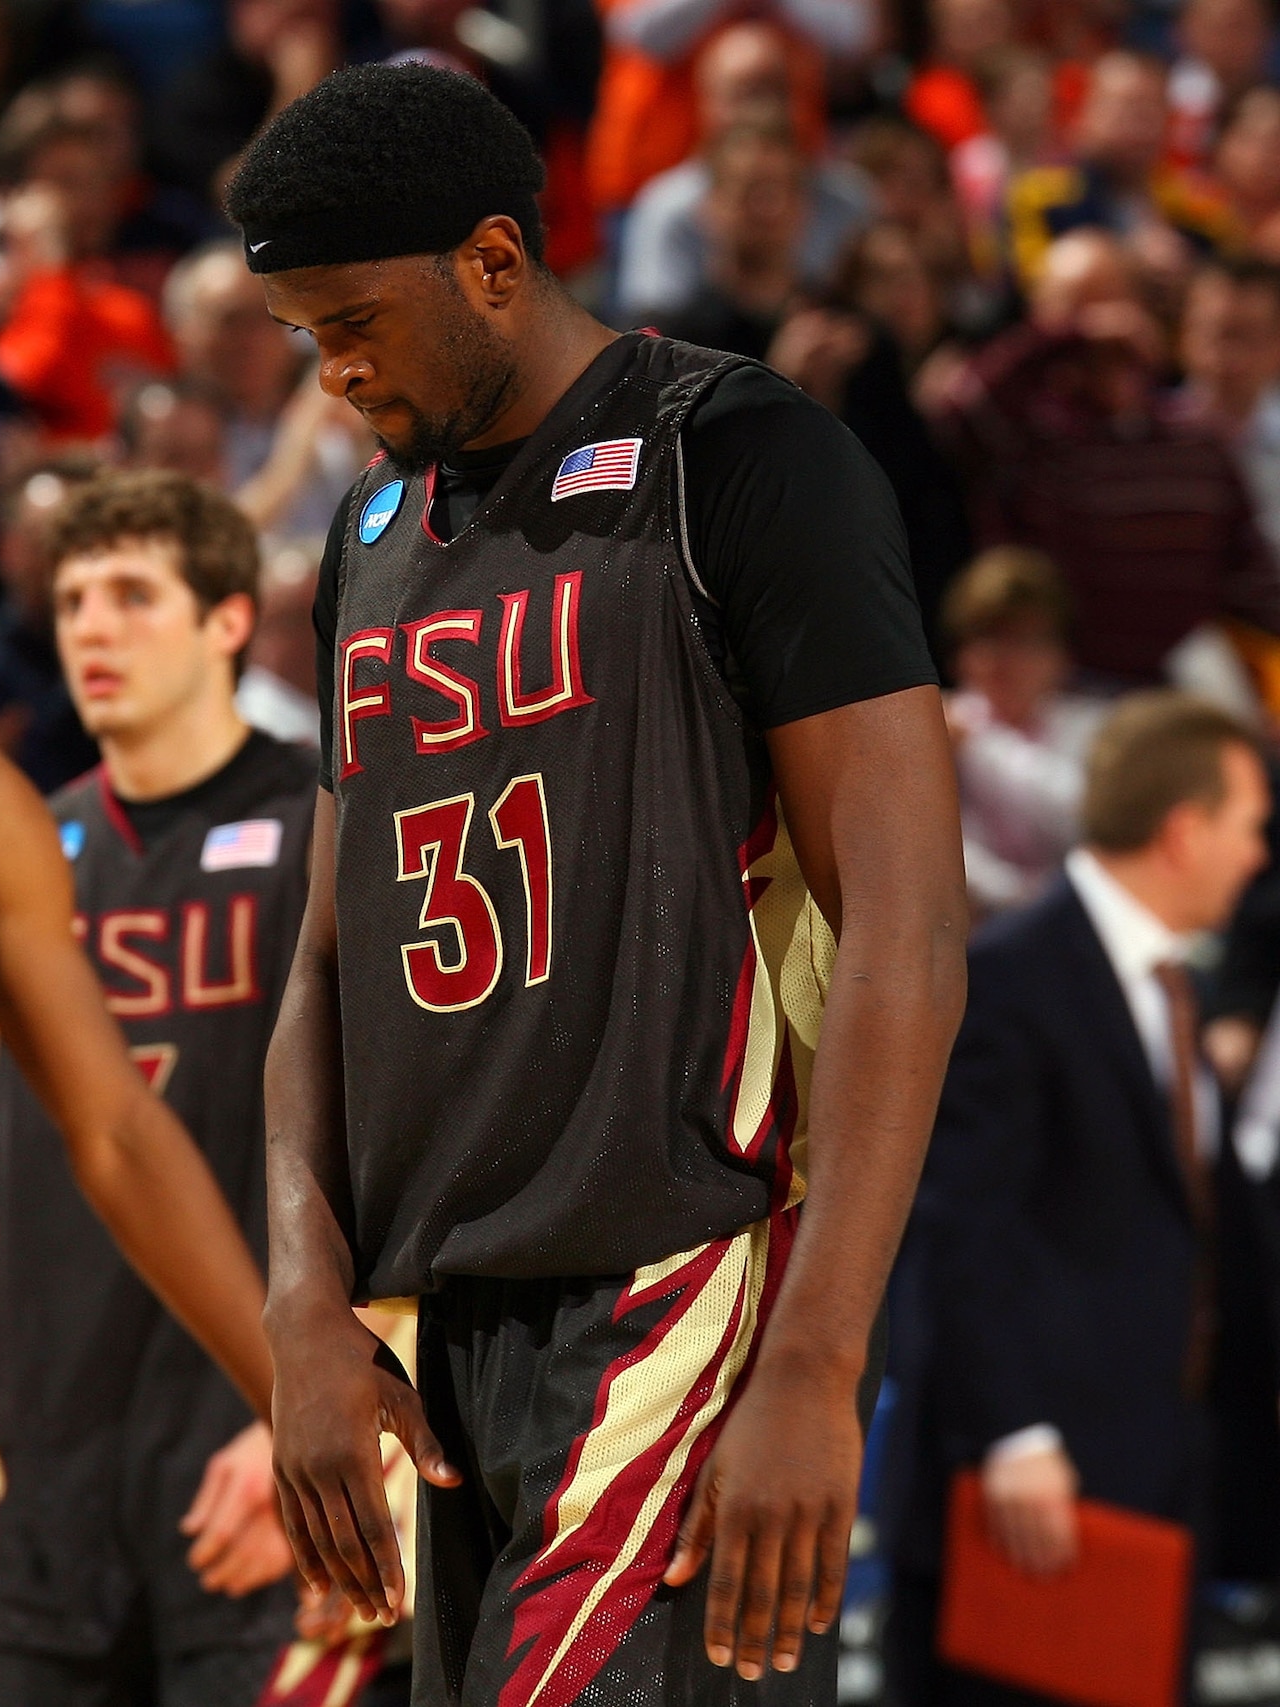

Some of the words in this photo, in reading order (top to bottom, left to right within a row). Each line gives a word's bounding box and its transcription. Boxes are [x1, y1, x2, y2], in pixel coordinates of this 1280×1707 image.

[340, 570, 596, 781] FSU
[72, 893, 262, 1019] SU
[393, 772, 553, 1014] 31
